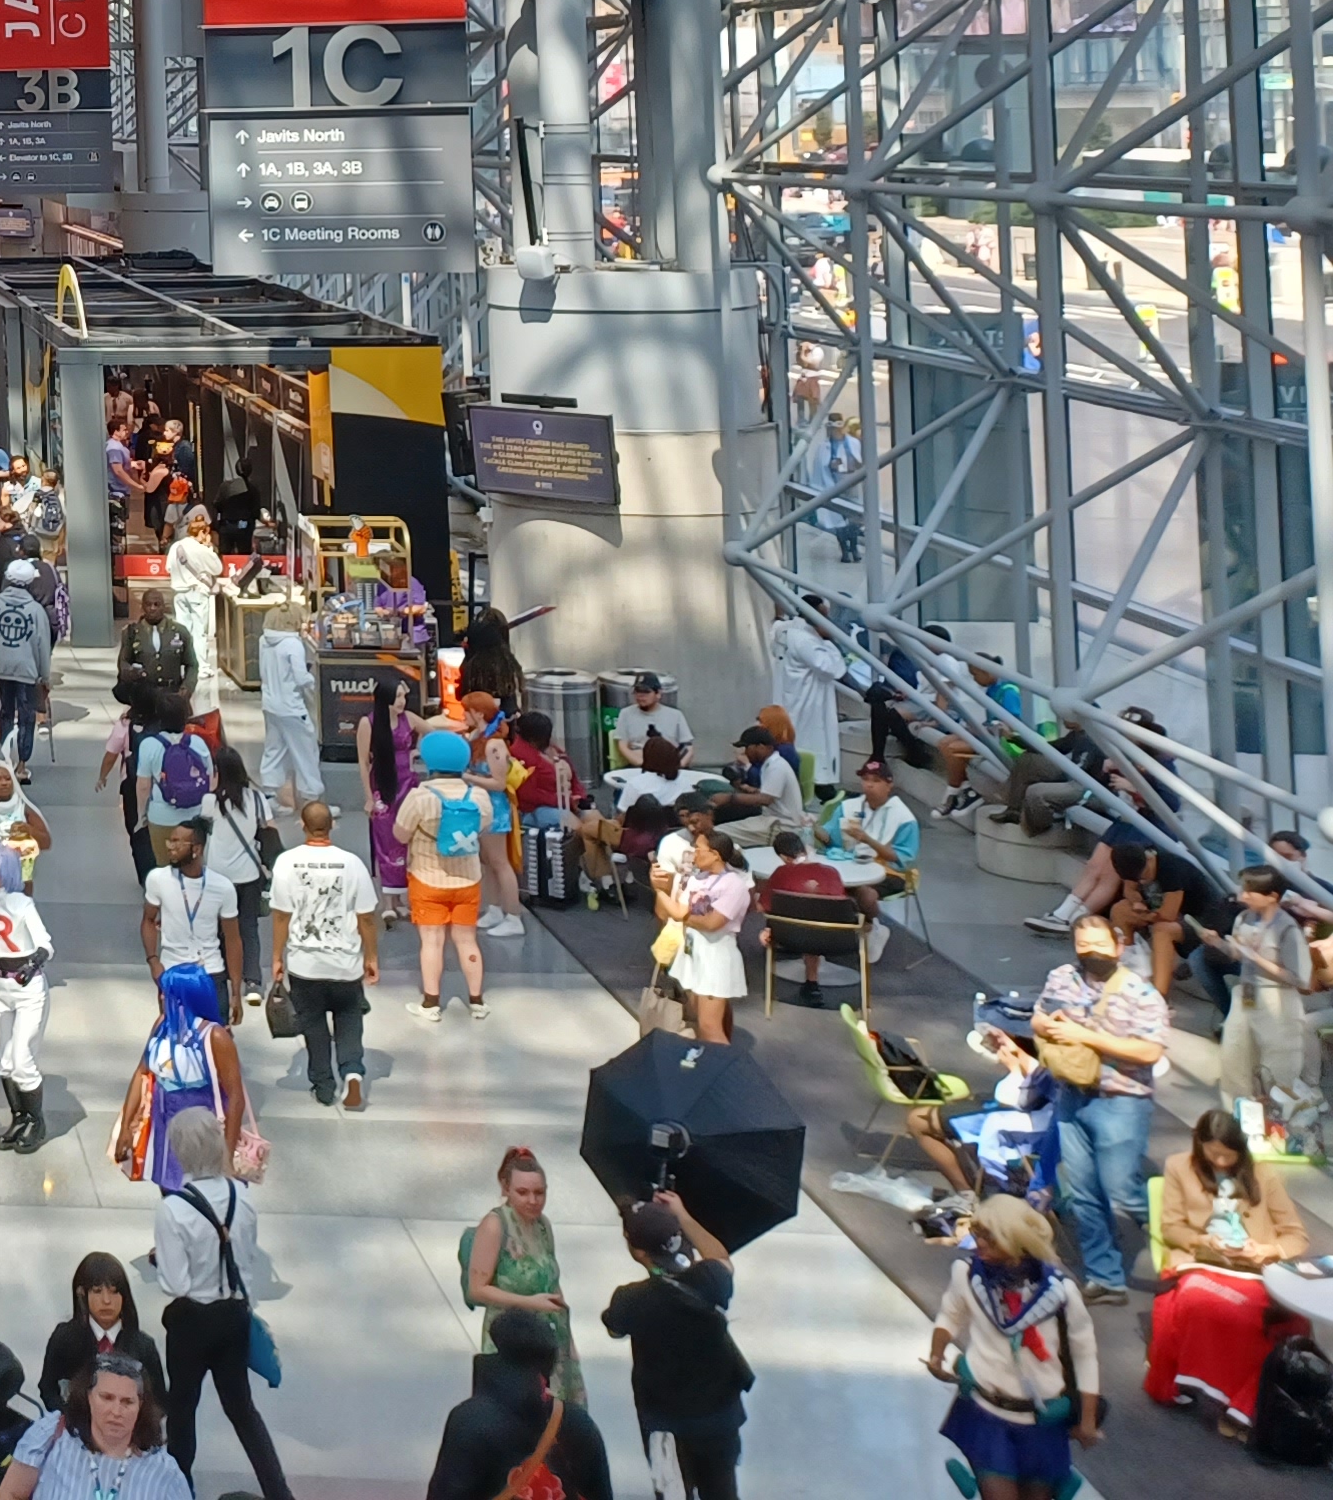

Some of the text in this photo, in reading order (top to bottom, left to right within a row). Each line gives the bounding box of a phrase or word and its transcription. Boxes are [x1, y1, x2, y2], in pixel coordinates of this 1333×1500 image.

[272, 25, 402, 108] 1C
[17, 69, 80, 112] 3B
[257, 128, 345, 143] Javits North
[259, 161, 362, 178] 1A, 1B, 3A, 3B
[261, 227, 400, 242] 1C Meeting Rooms
